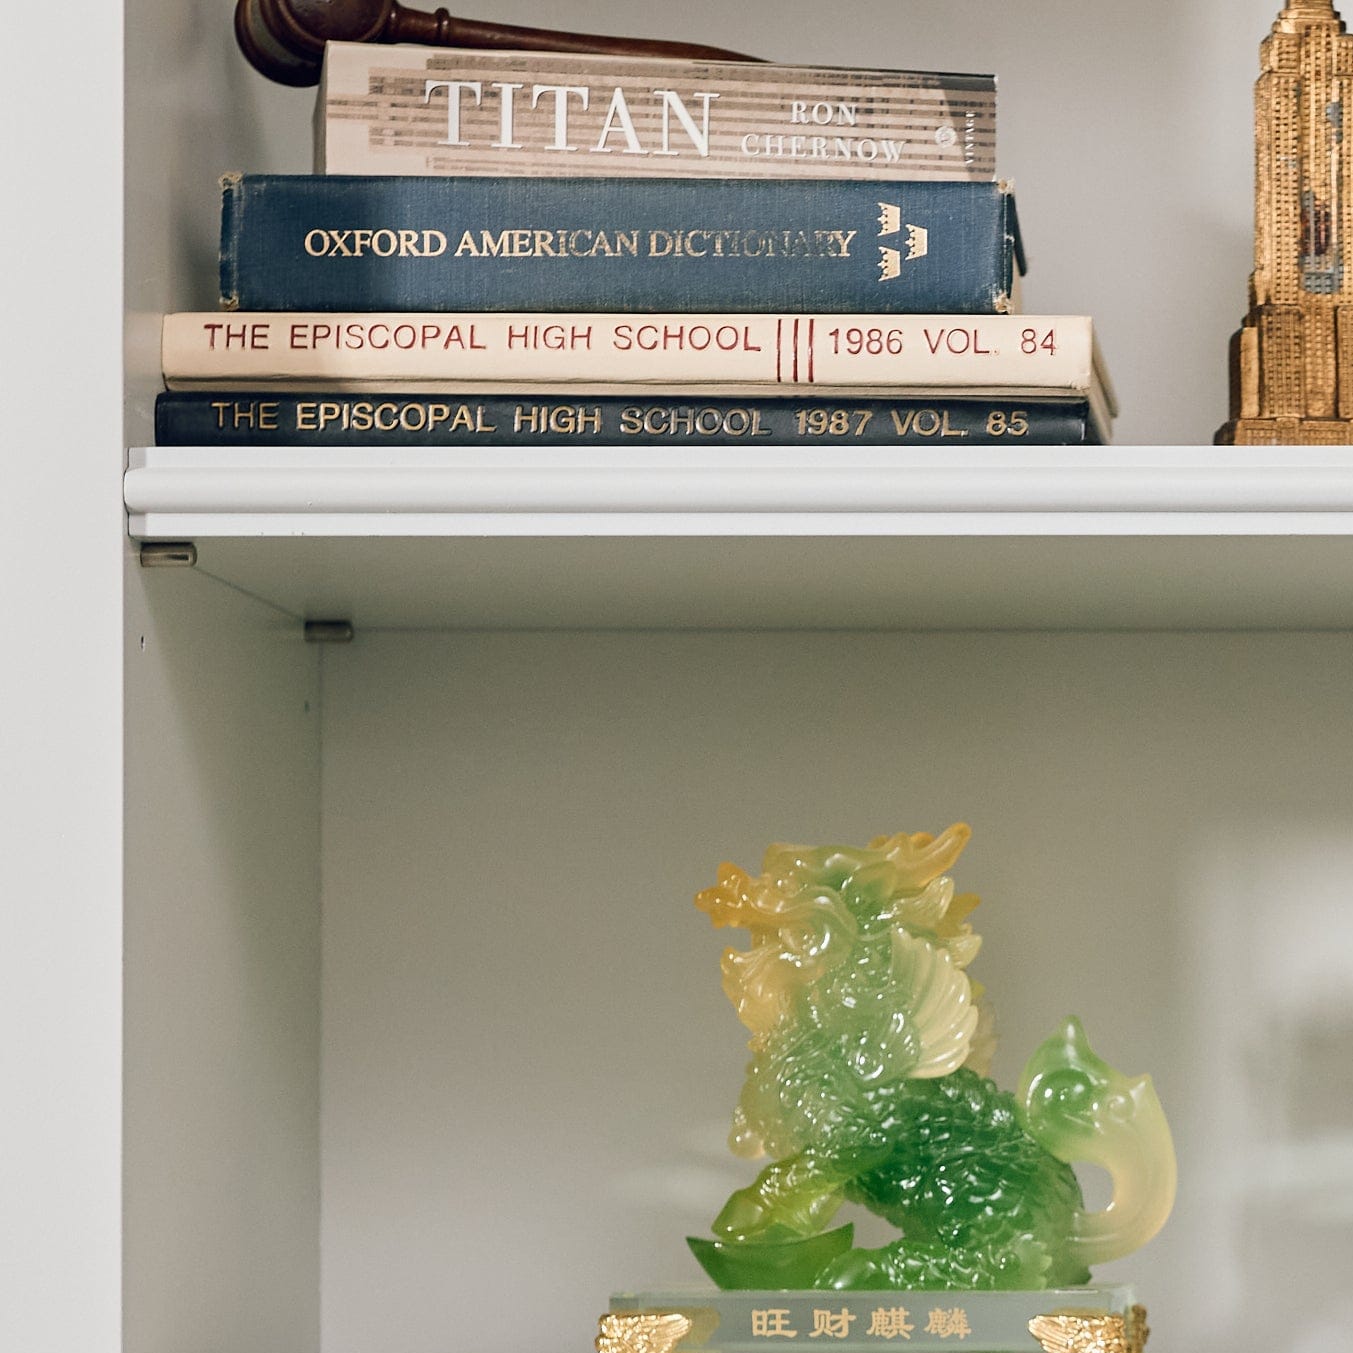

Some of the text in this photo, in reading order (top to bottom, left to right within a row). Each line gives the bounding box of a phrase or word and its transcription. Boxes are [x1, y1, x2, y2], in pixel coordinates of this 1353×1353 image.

[424, 79, 721, 157] TITAN
[790, 100, 859, 127] RON
[740, 133, 907, 163] CHERNOW
[965, 110, 976, 165] VINTAGE
[304, 229, 858, 258] OXFORD AMERICAN DICTIONARY
[203, 323, 1058, 356] THE EPISCOPAL HIGH SCHOOL 1986 VOL. 84
[211, 402, 1030, 437] THE EPISCOPAL HIGH SCHOOL 1987 VOL. 85
[751, 1306, 973, 1340] 旺财麒麟
